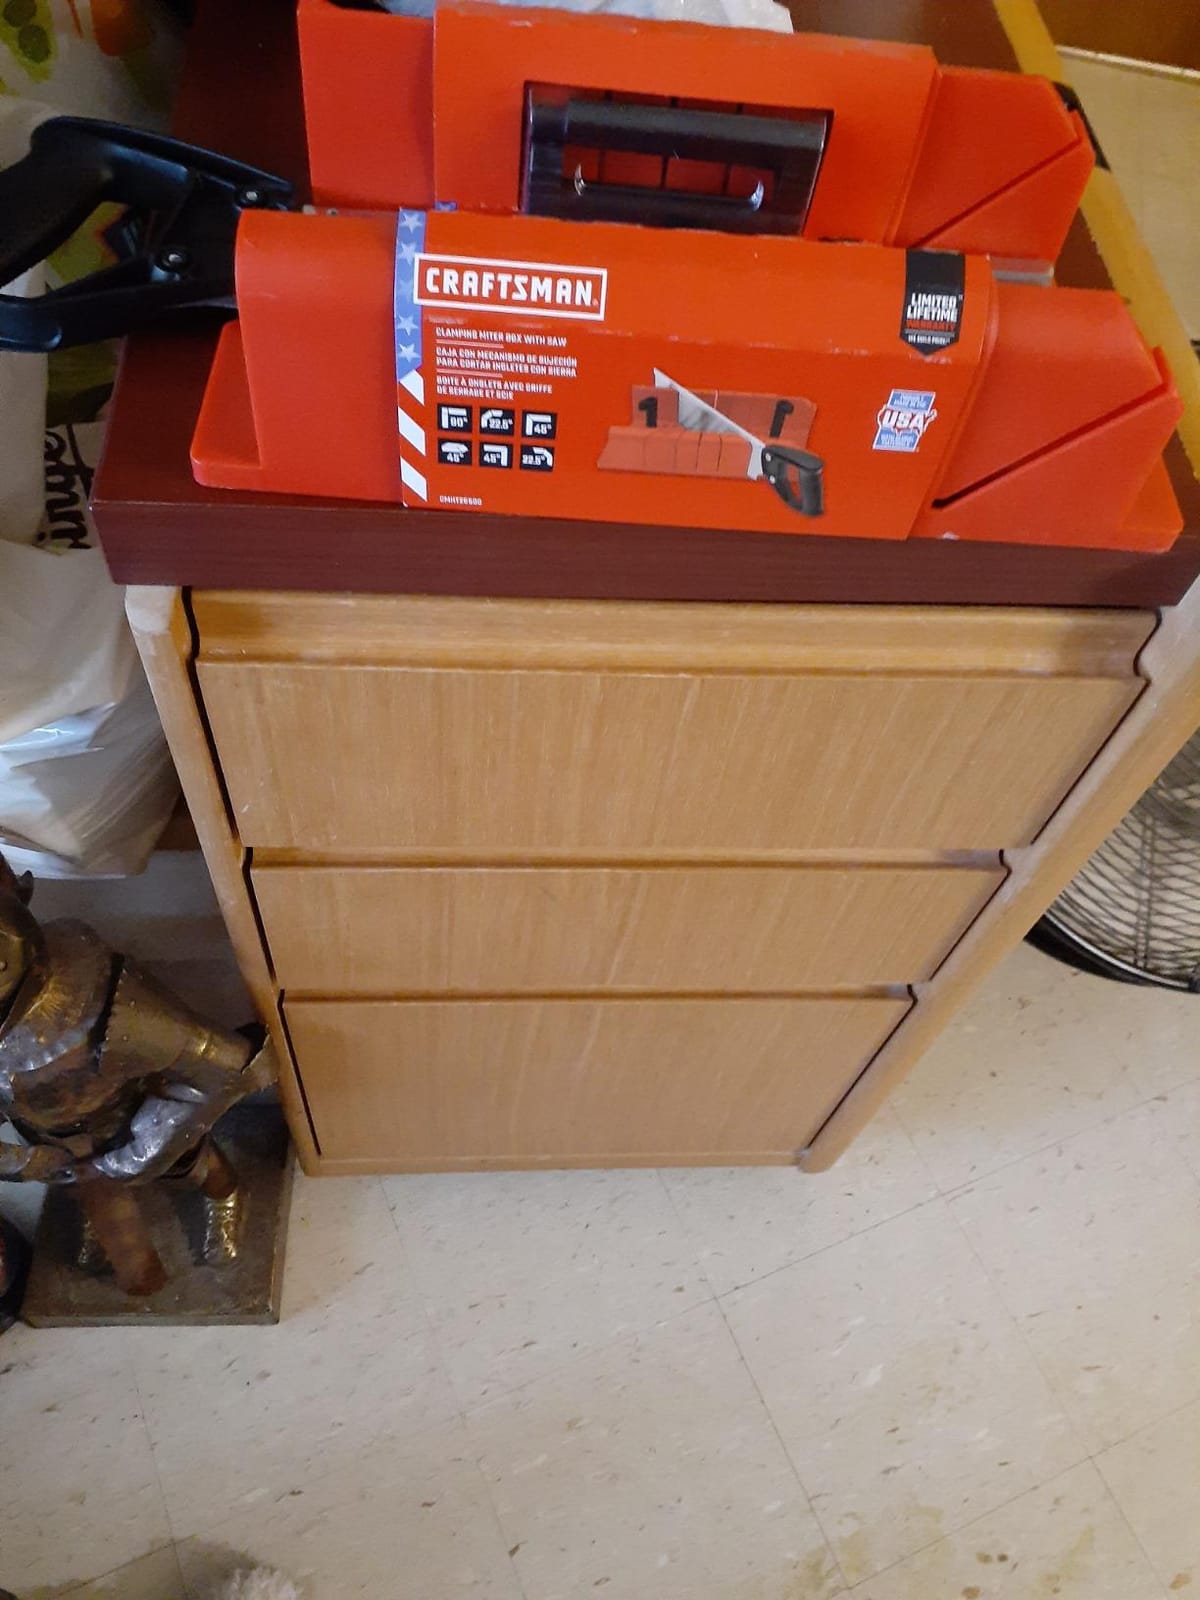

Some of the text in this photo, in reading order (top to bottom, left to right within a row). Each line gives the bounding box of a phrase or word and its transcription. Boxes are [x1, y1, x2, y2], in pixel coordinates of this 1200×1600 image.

[426, 266, 593, 307] CRAFTSMAN
[911, 292, 957, 309] LIMITED
[906, 305, 958, 323] LIFETIME
[436, 327, 567, 347] CLAMPING MITER BOX WITH SAW
[436, 346, 458, 358] CAJA
[459, 348, 476, 359] CON
[476, 349, 525, 364] MECANISMO
[526, 352, 538, 364] DE
[436, 357, 577, 377] PARA CORTAR INGLETES CON SIERRA
[436, 385, 448, 395] DE
[485, 388, 496, 399] ET
[504, 380, 524, 392] AVEC
[882, 409, 924, 430] USA
